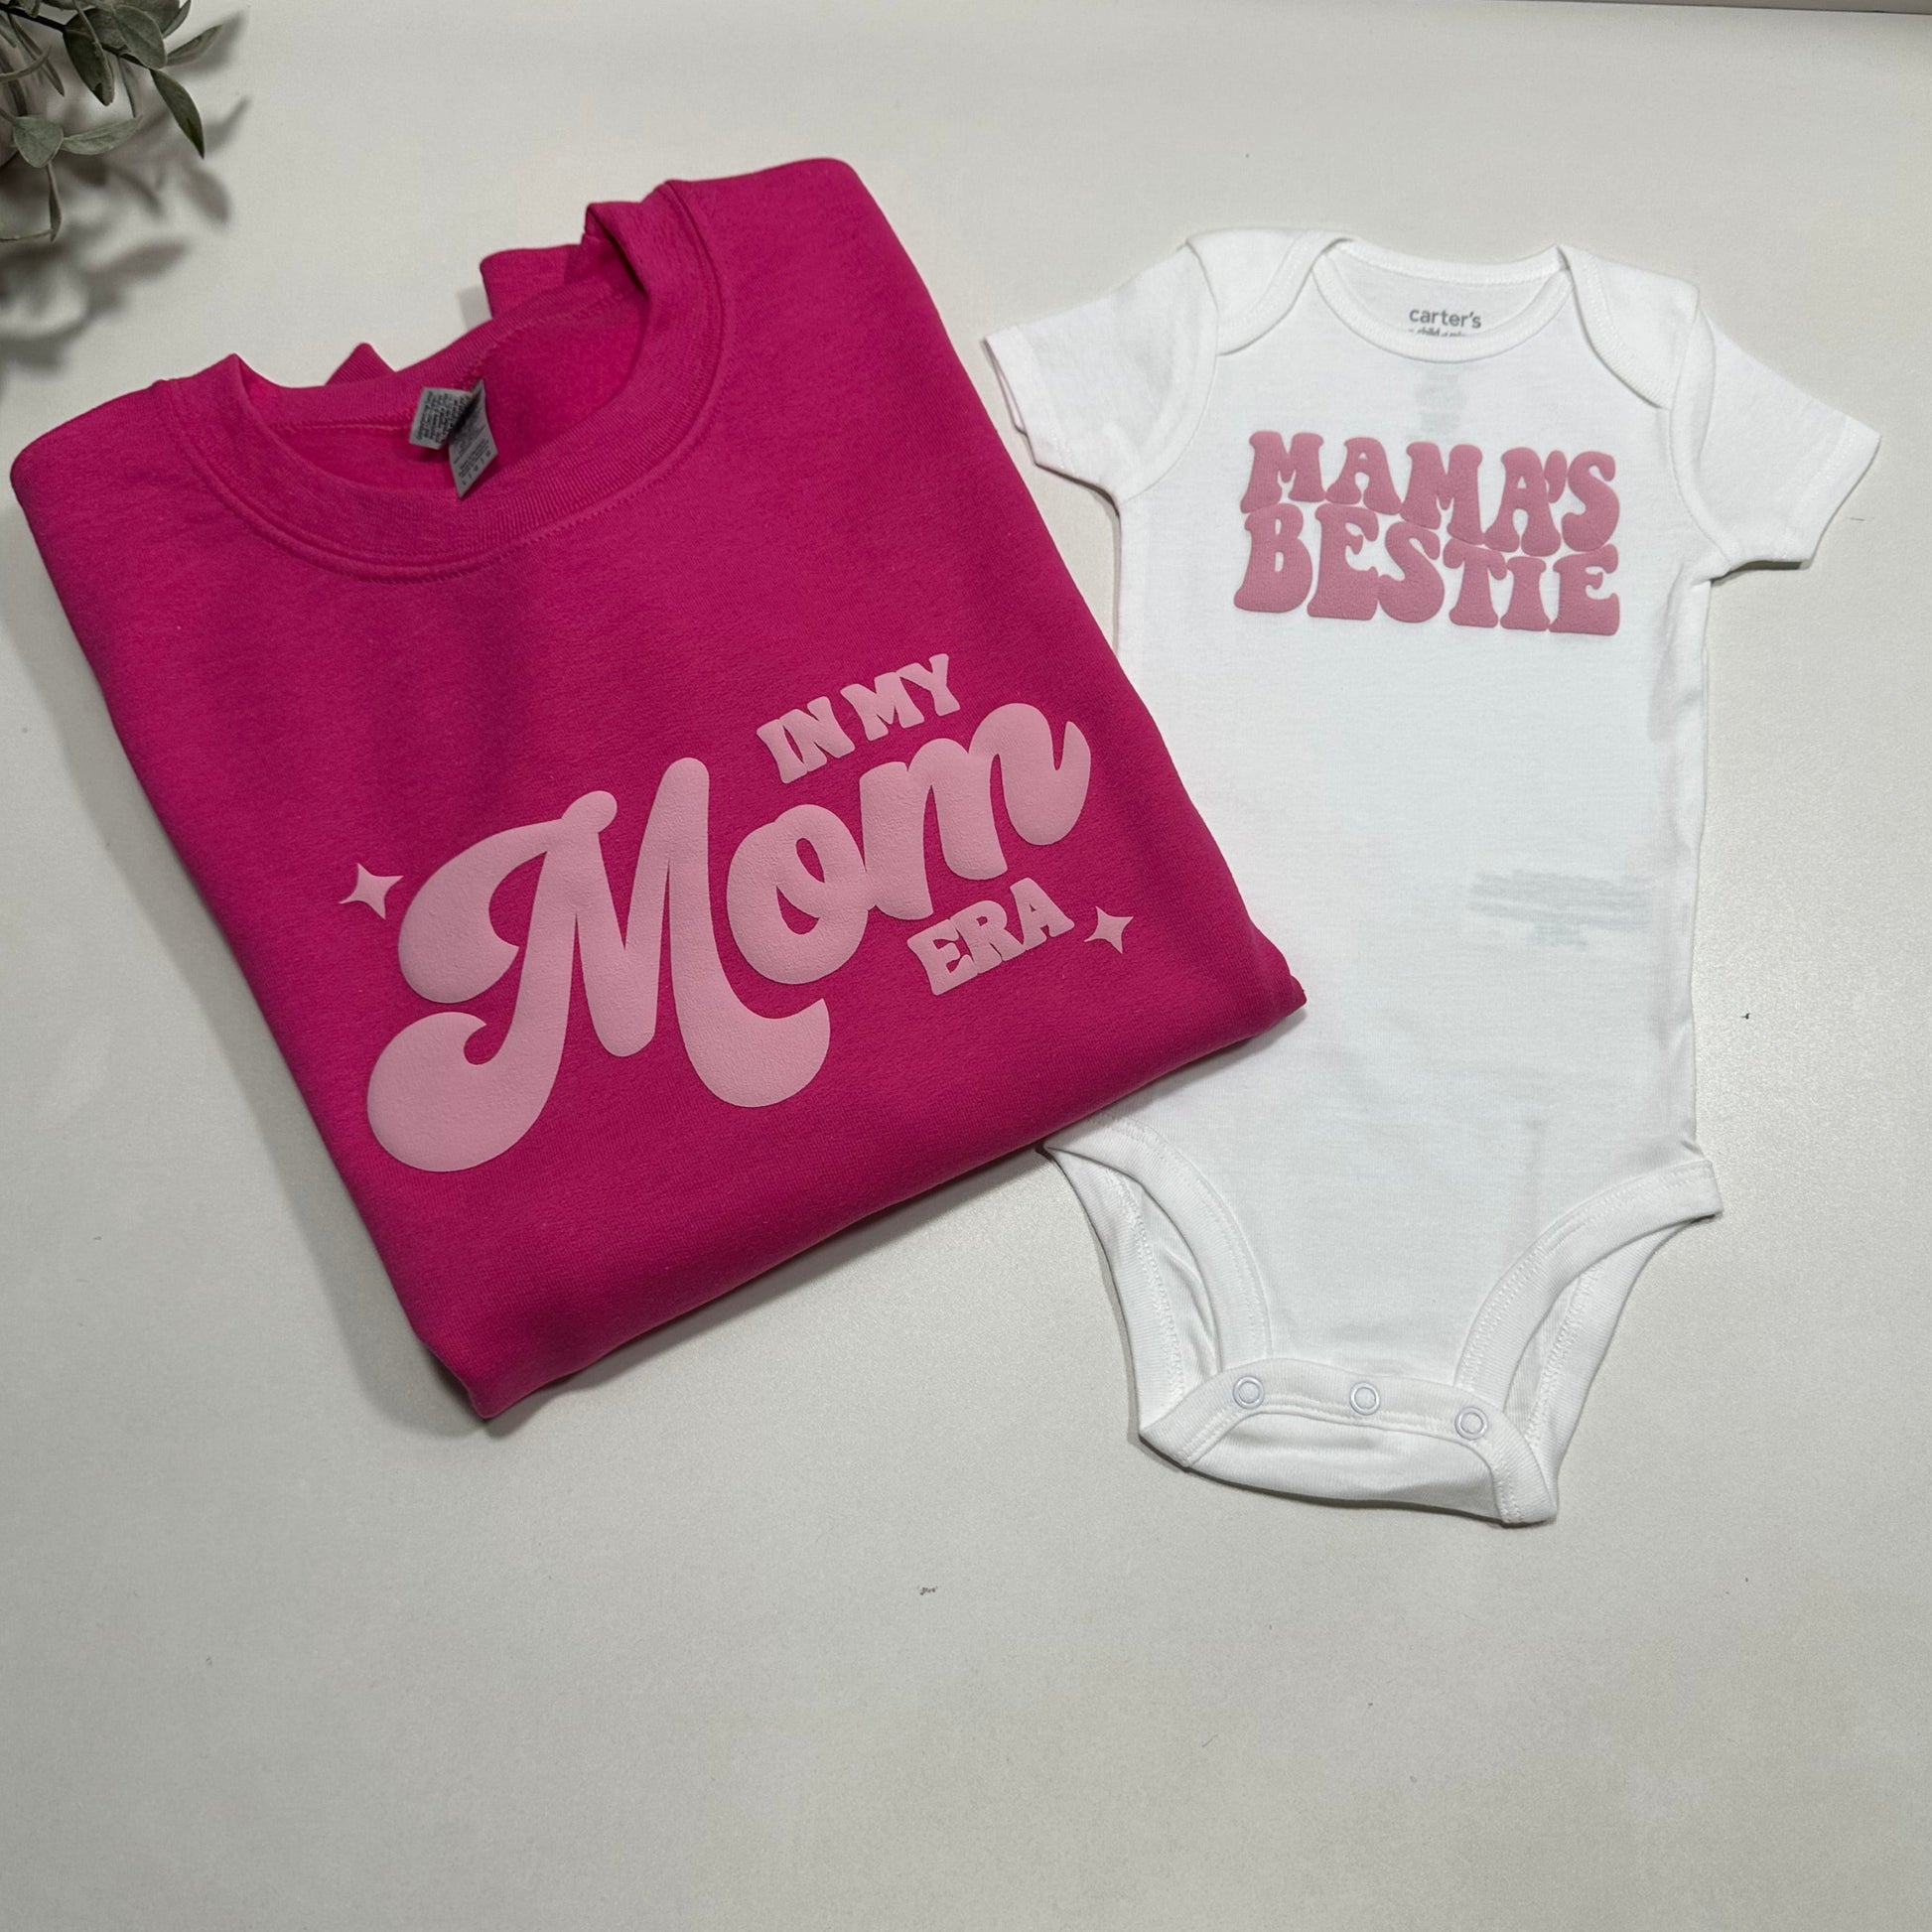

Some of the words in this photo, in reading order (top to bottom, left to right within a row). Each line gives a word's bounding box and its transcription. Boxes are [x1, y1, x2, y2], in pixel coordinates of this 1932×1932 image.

[1409, 309, 1482, 329] carter's
[1240, 430, 1620, 557] MAMA'S
[1233, 502, 1620, 635] BESTIE
[756, 696, 855, 783] IN
[840, 653, 961, 741] MY
[366, 703, 1092, 1172] Mom
[907, 877, 1075, 996] ERA
